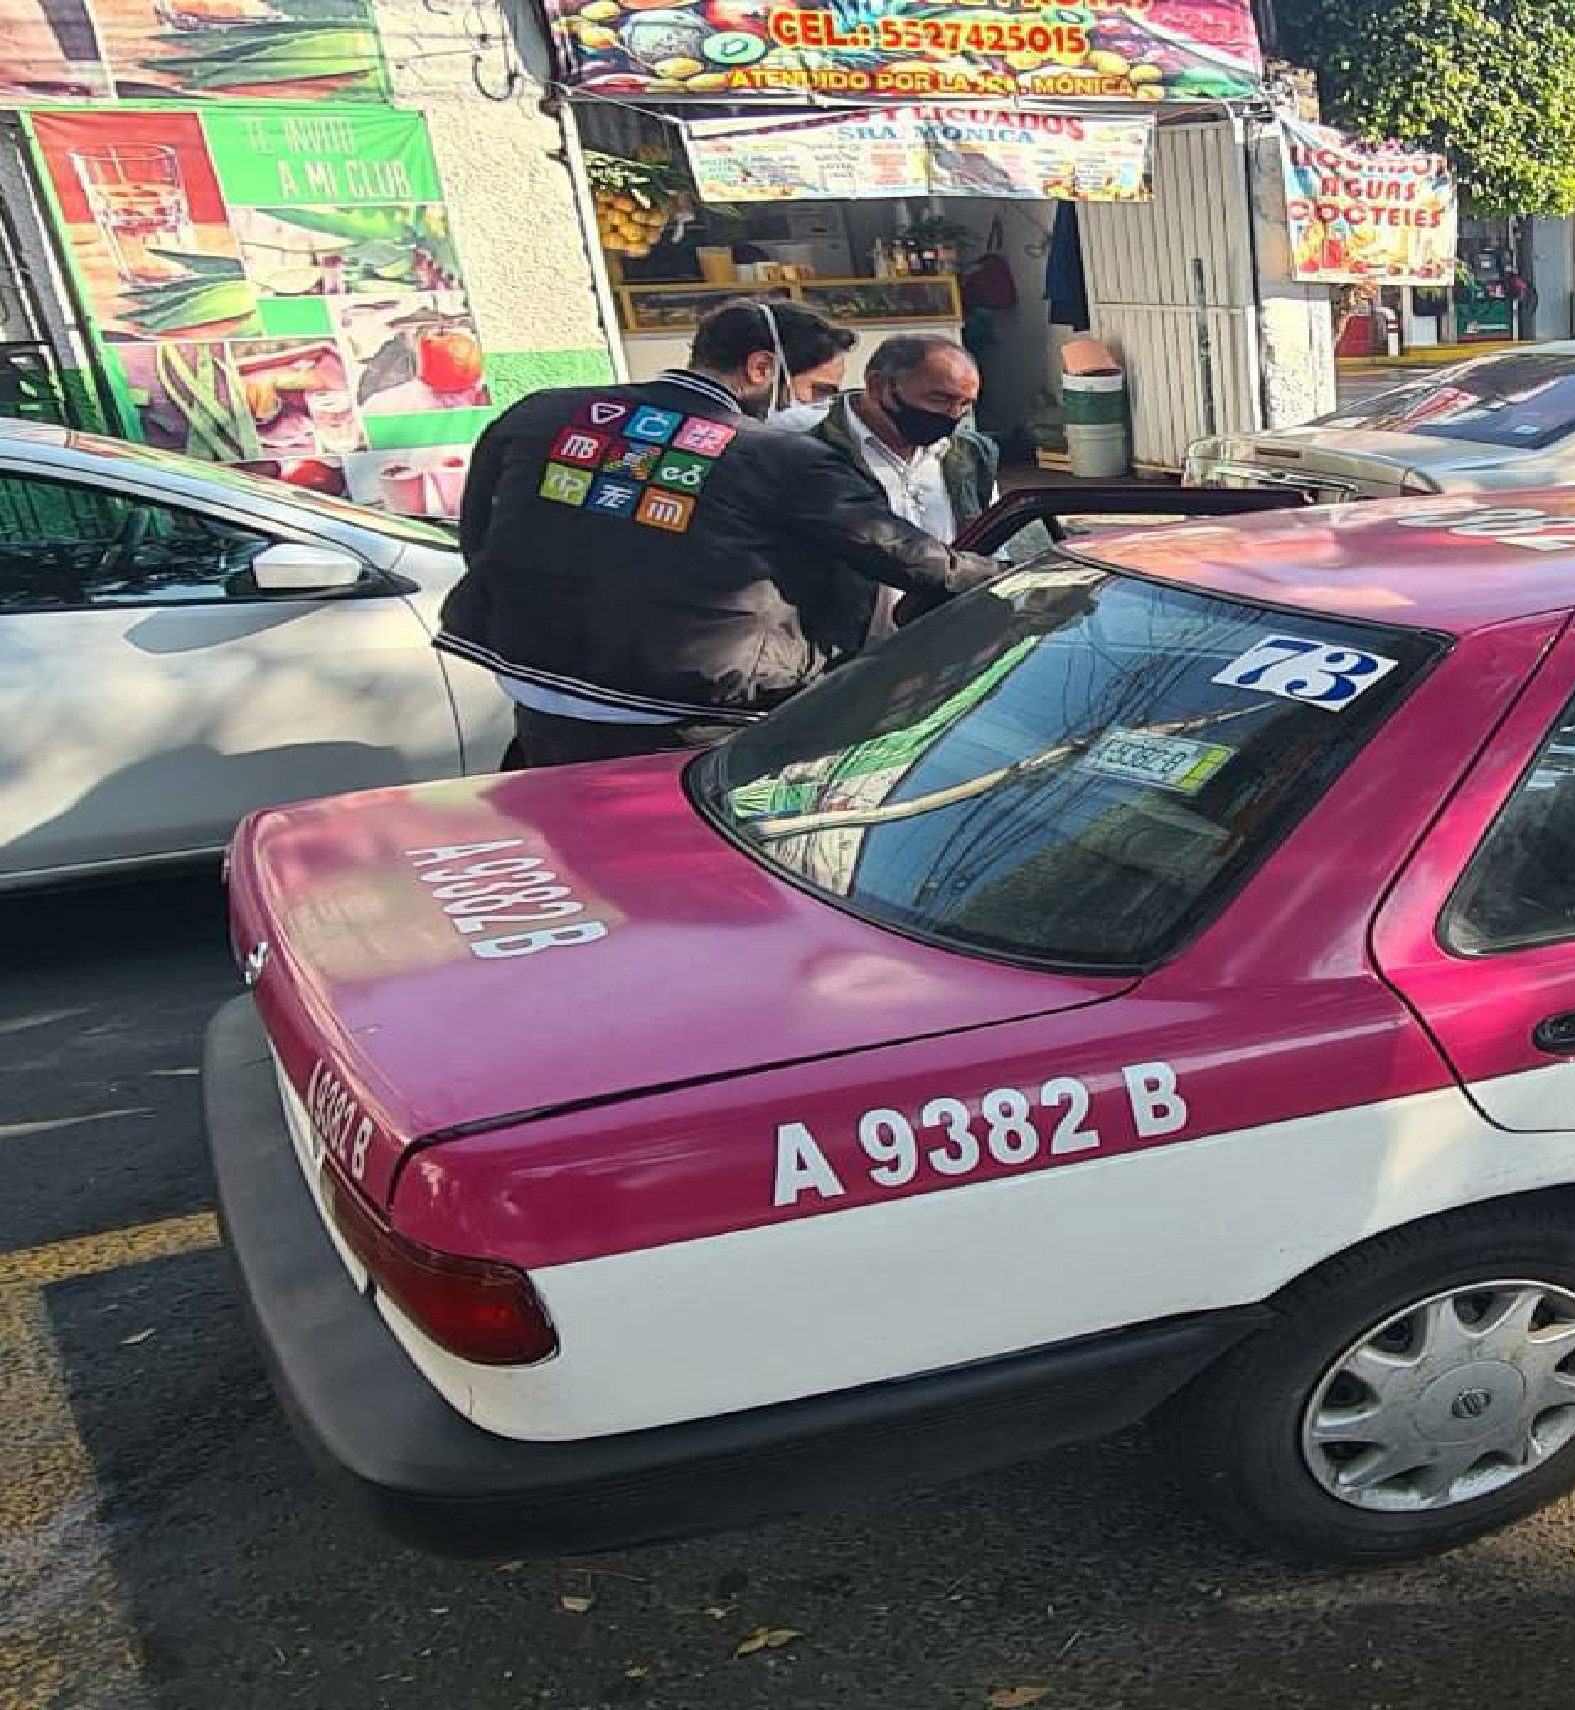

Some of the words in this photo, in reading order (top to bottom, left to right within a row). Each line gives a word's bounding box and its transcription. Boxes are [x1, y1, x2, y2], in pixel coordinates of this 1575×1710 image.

[879, 19, 1086, 53] 5527425015
[875, 71, 933, 91] POR
[304, 159, 338, 199] MI
[347, 159, 413, 199] CLUB
[1319, 175, 1416, 201] AGUAS
[1233, 637, 1380, 702] 73
[403, 838, 525, 866] A
[420, 857, 585, 934] 9382
[470, 919, 608, 960] B
[350, 1115, 373, 1180] B
[773, 1122, 847, 1207] A
[858, 1077, 1101, 1188] 9382
[1121, 1061, 1189, 1138] B
